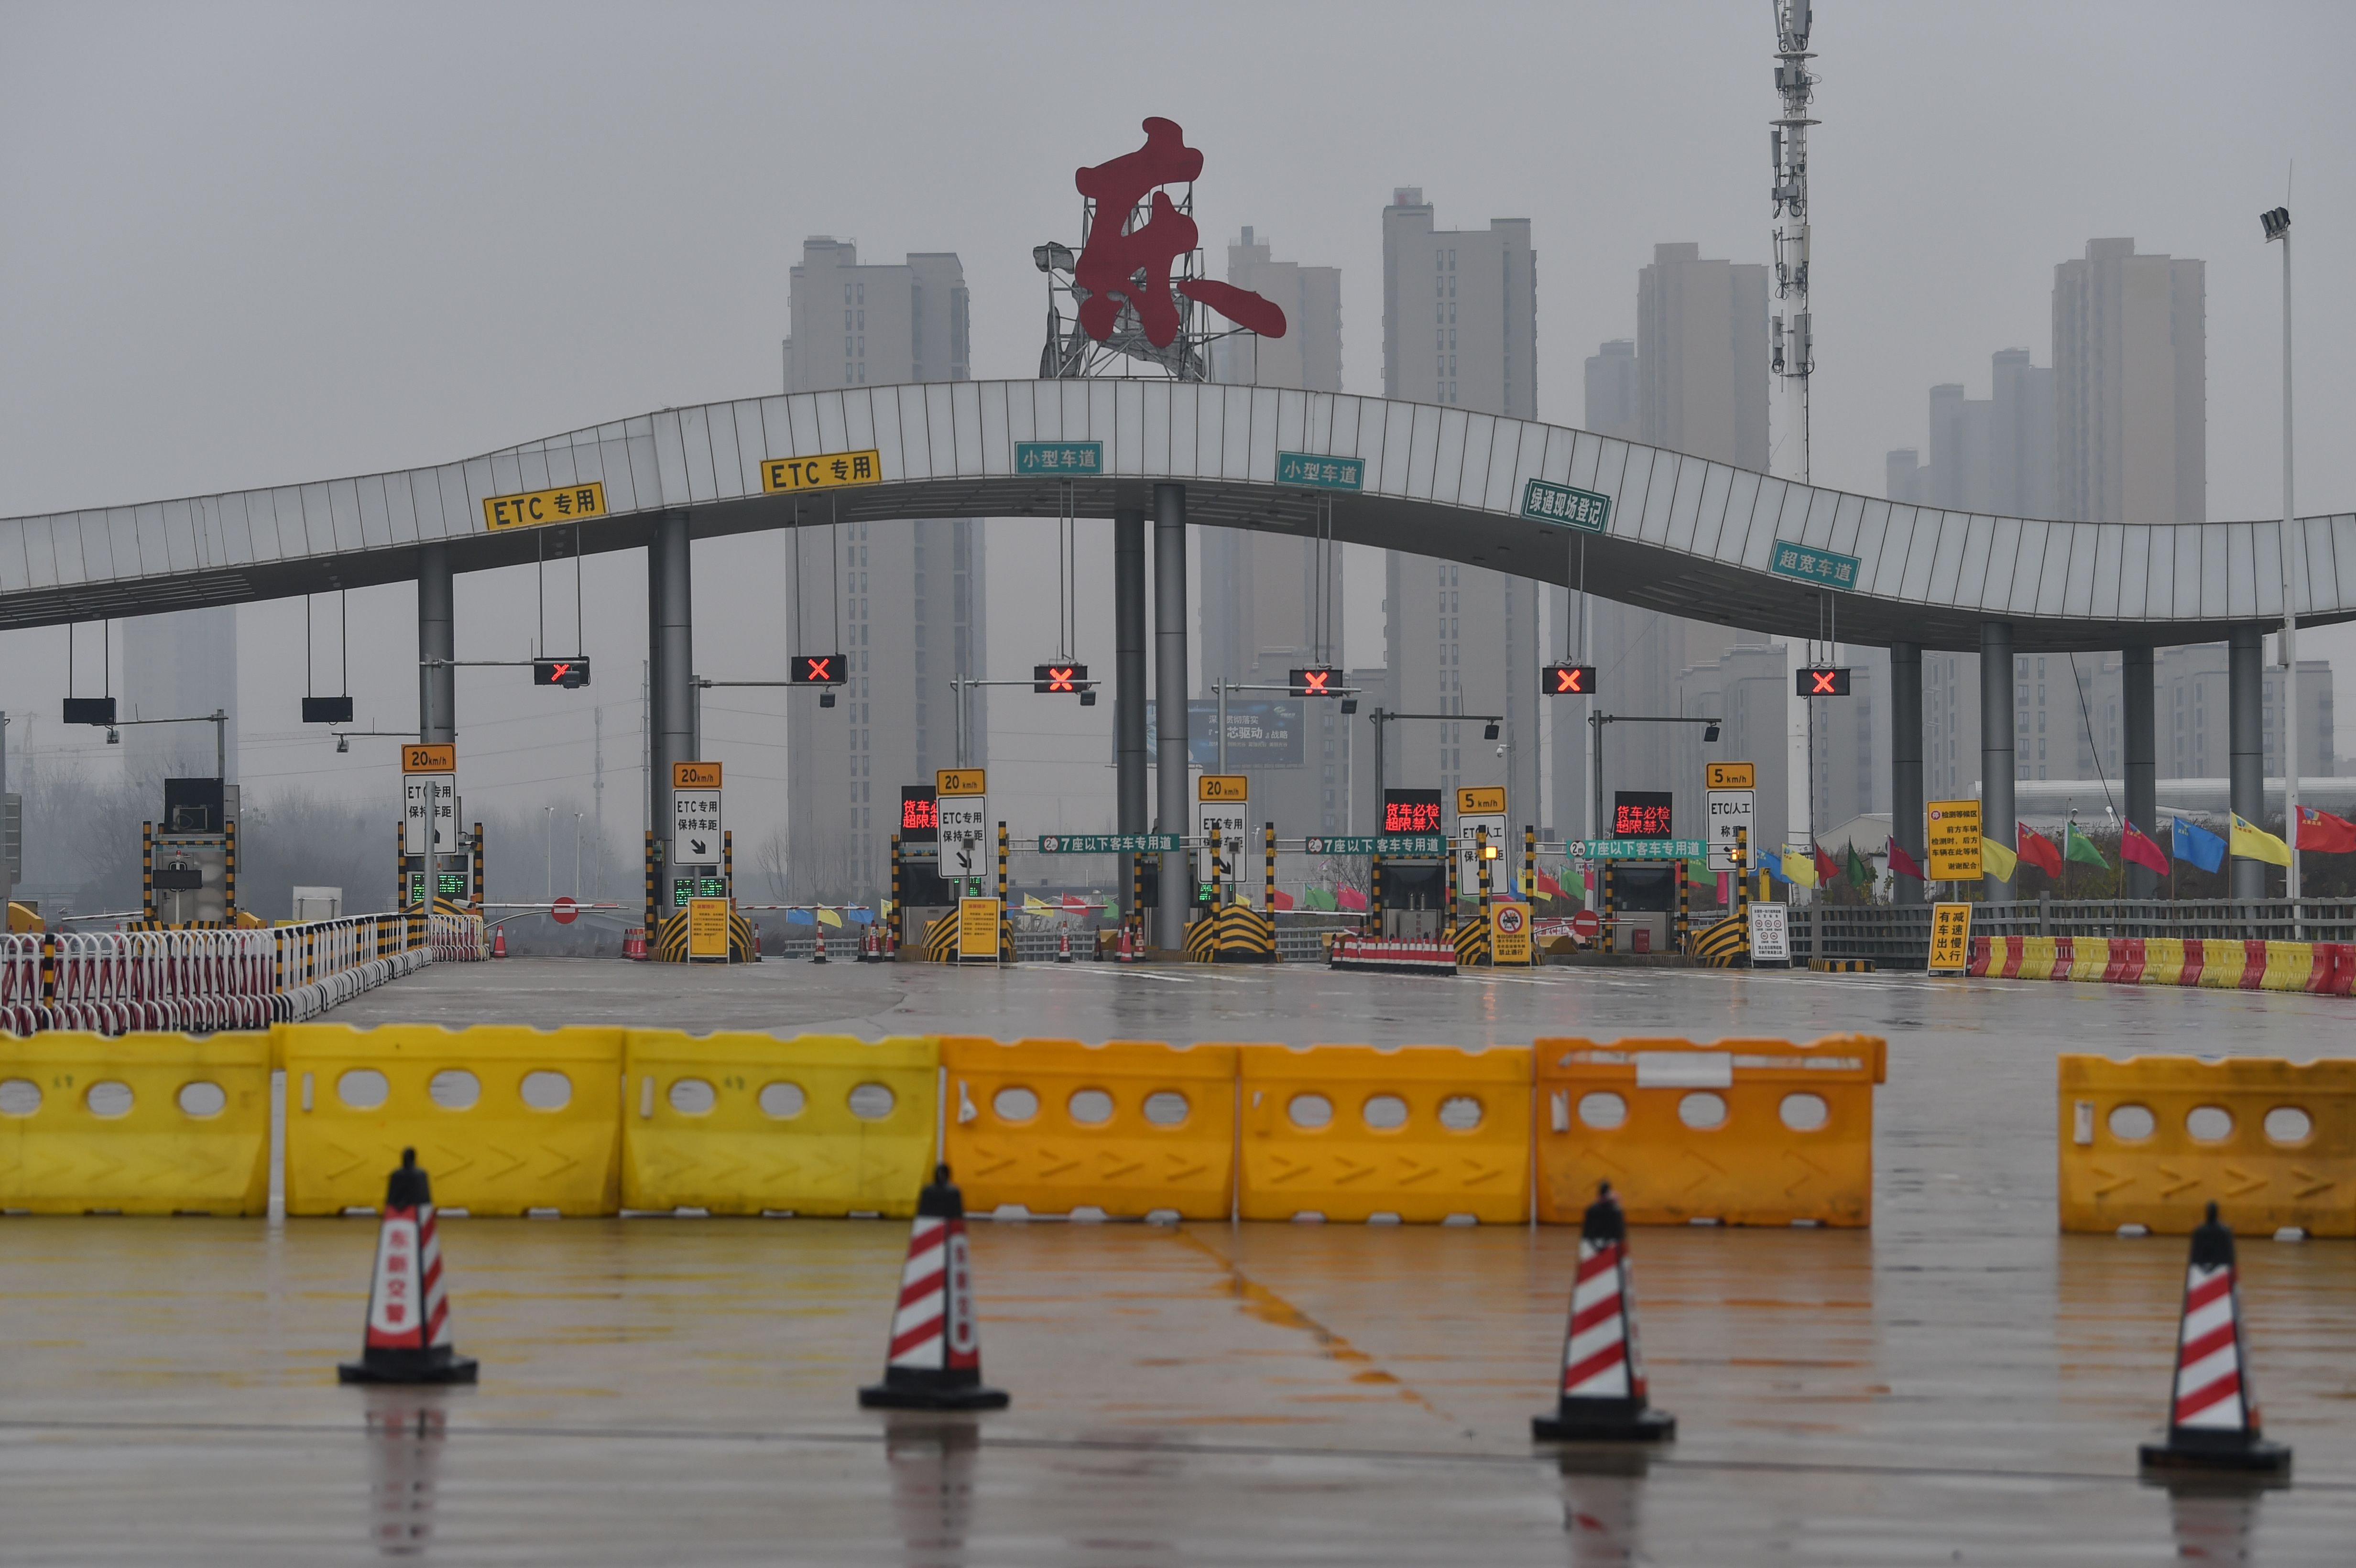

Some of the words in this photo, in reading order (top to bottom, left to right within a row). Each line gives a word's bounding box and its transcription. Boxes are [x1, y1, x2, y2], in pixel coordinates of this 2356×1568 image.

[1023, 449, 1096, 468] 小型车道
[771, 461, 819, 488] ETC
[830, 456, 871, 480] 专用
[1284, 460, 1357, 484] 小型车道
[494, 497, 544, 525] ETC
[554, 489, 595, 515] 专用
[1529, 487, 1602, 525] 绿通现场登记
[1779, 549, 1852, 582] 超宽车道
[1209, 715, 1258, 724] 深贯彻落实
[945, 775, 959, 789] 20
[1714, 769, 1723, 783] 5
[1207, 781, 1221, 795] 20
[1465, 794, 1474, 807] 5
[1386, 803, 1440, 817] 货车必检
[1617, 806, 1670, 820] 货车必检
[678, 818, 717, 830] 保持车距
[1385, 817, 1440, 831] 超限禁入
[1615, 819, 1670, 834] 超限禁入
[1721, 825, 1740, 837] 称重
[1946, 826, 1978, 834] 前方车辆
[1061, 836, 1172, 851] 7座以下客车专用道
[1323, 838, 1439, 853] 7座以下客车专用道
[1588, 841, 1700, 856] 7座以下客车专用道
[1932, 848, 1978, 856] 车辆在此等候
[1935, 911, 1951, 961] 有车出入
[1949, 911, 1964, 961] 减速慢行
